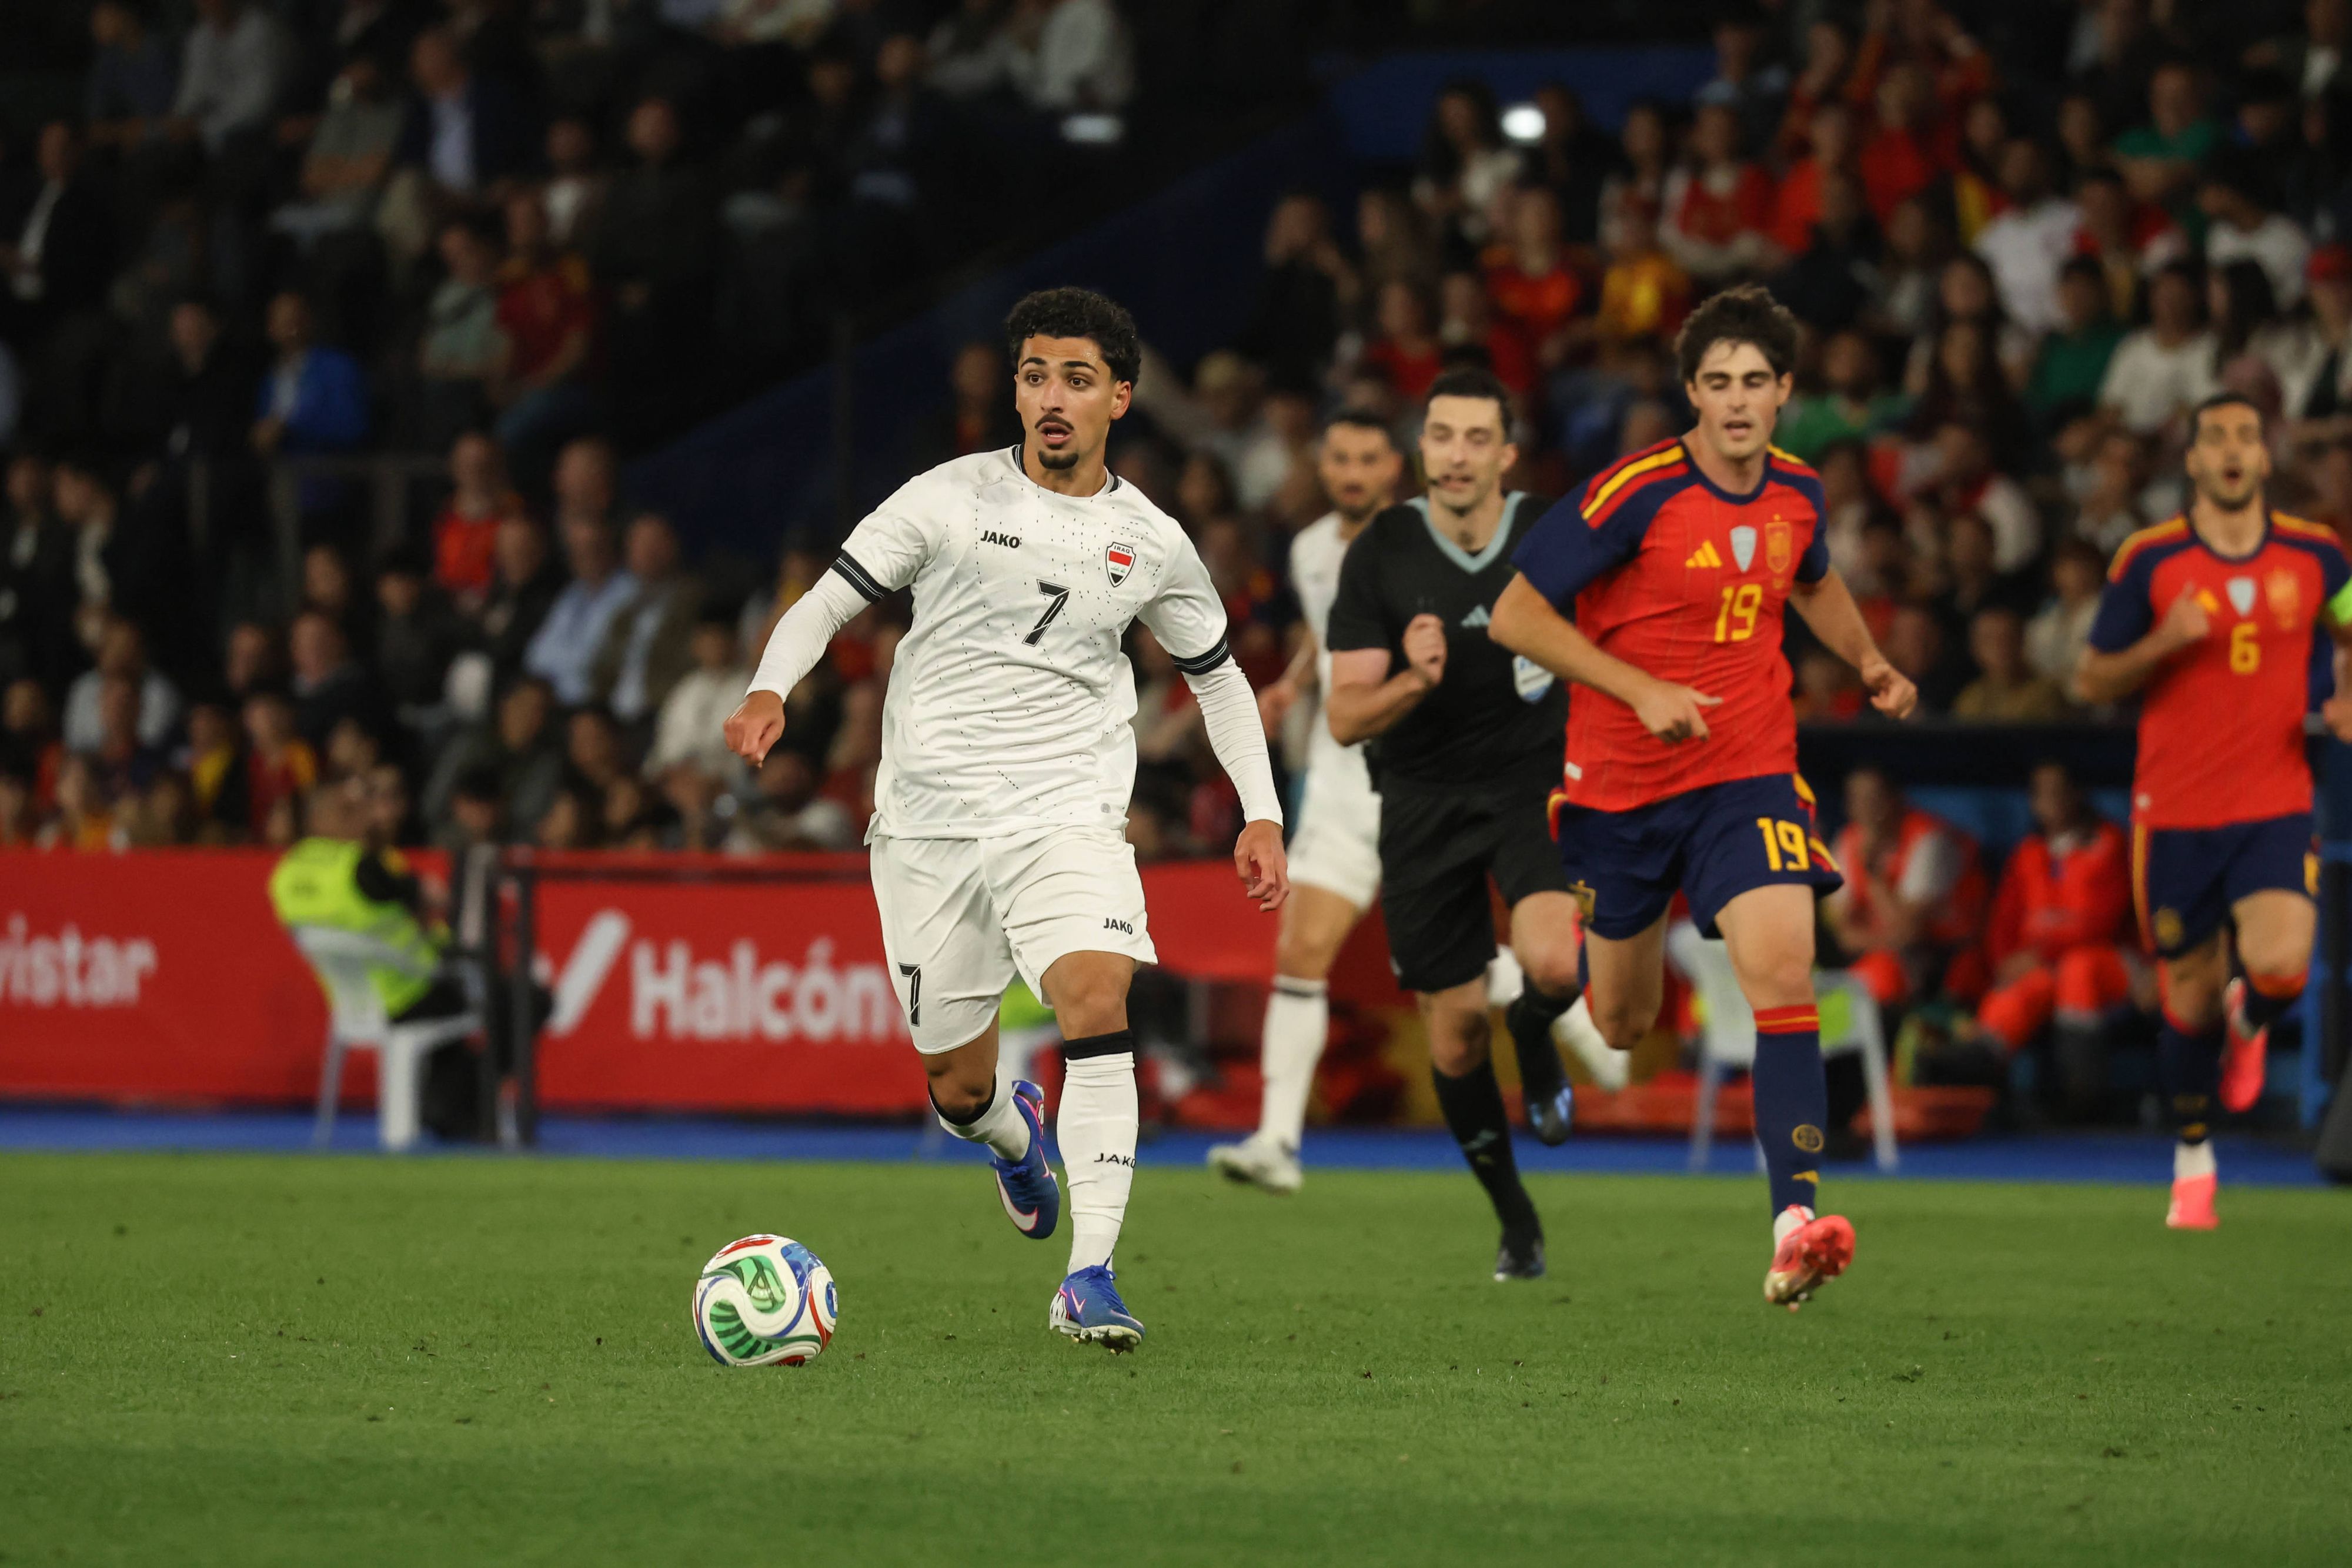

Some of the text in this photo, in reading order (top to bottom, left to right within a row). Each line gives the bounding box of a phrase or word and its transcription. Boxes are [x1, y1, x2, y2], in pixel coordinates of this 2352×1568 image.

[980, 530, 1020, 549] JAKO
[1114, 545, 1130, 554] IRAQ
[1021, 579, 1071, 647] 7
[1714, 583, 1763, 643] 19
[2229, 622, 2261, 674] 6
[1756, 817, 1810, 871] 19
[1103, 918, 1132, 935] JAKO
[632, 937, 890, 1042] Halcón
[897, 962, 921, 1027] 7
[1094, 1153, 1136, 1169] JAKO
